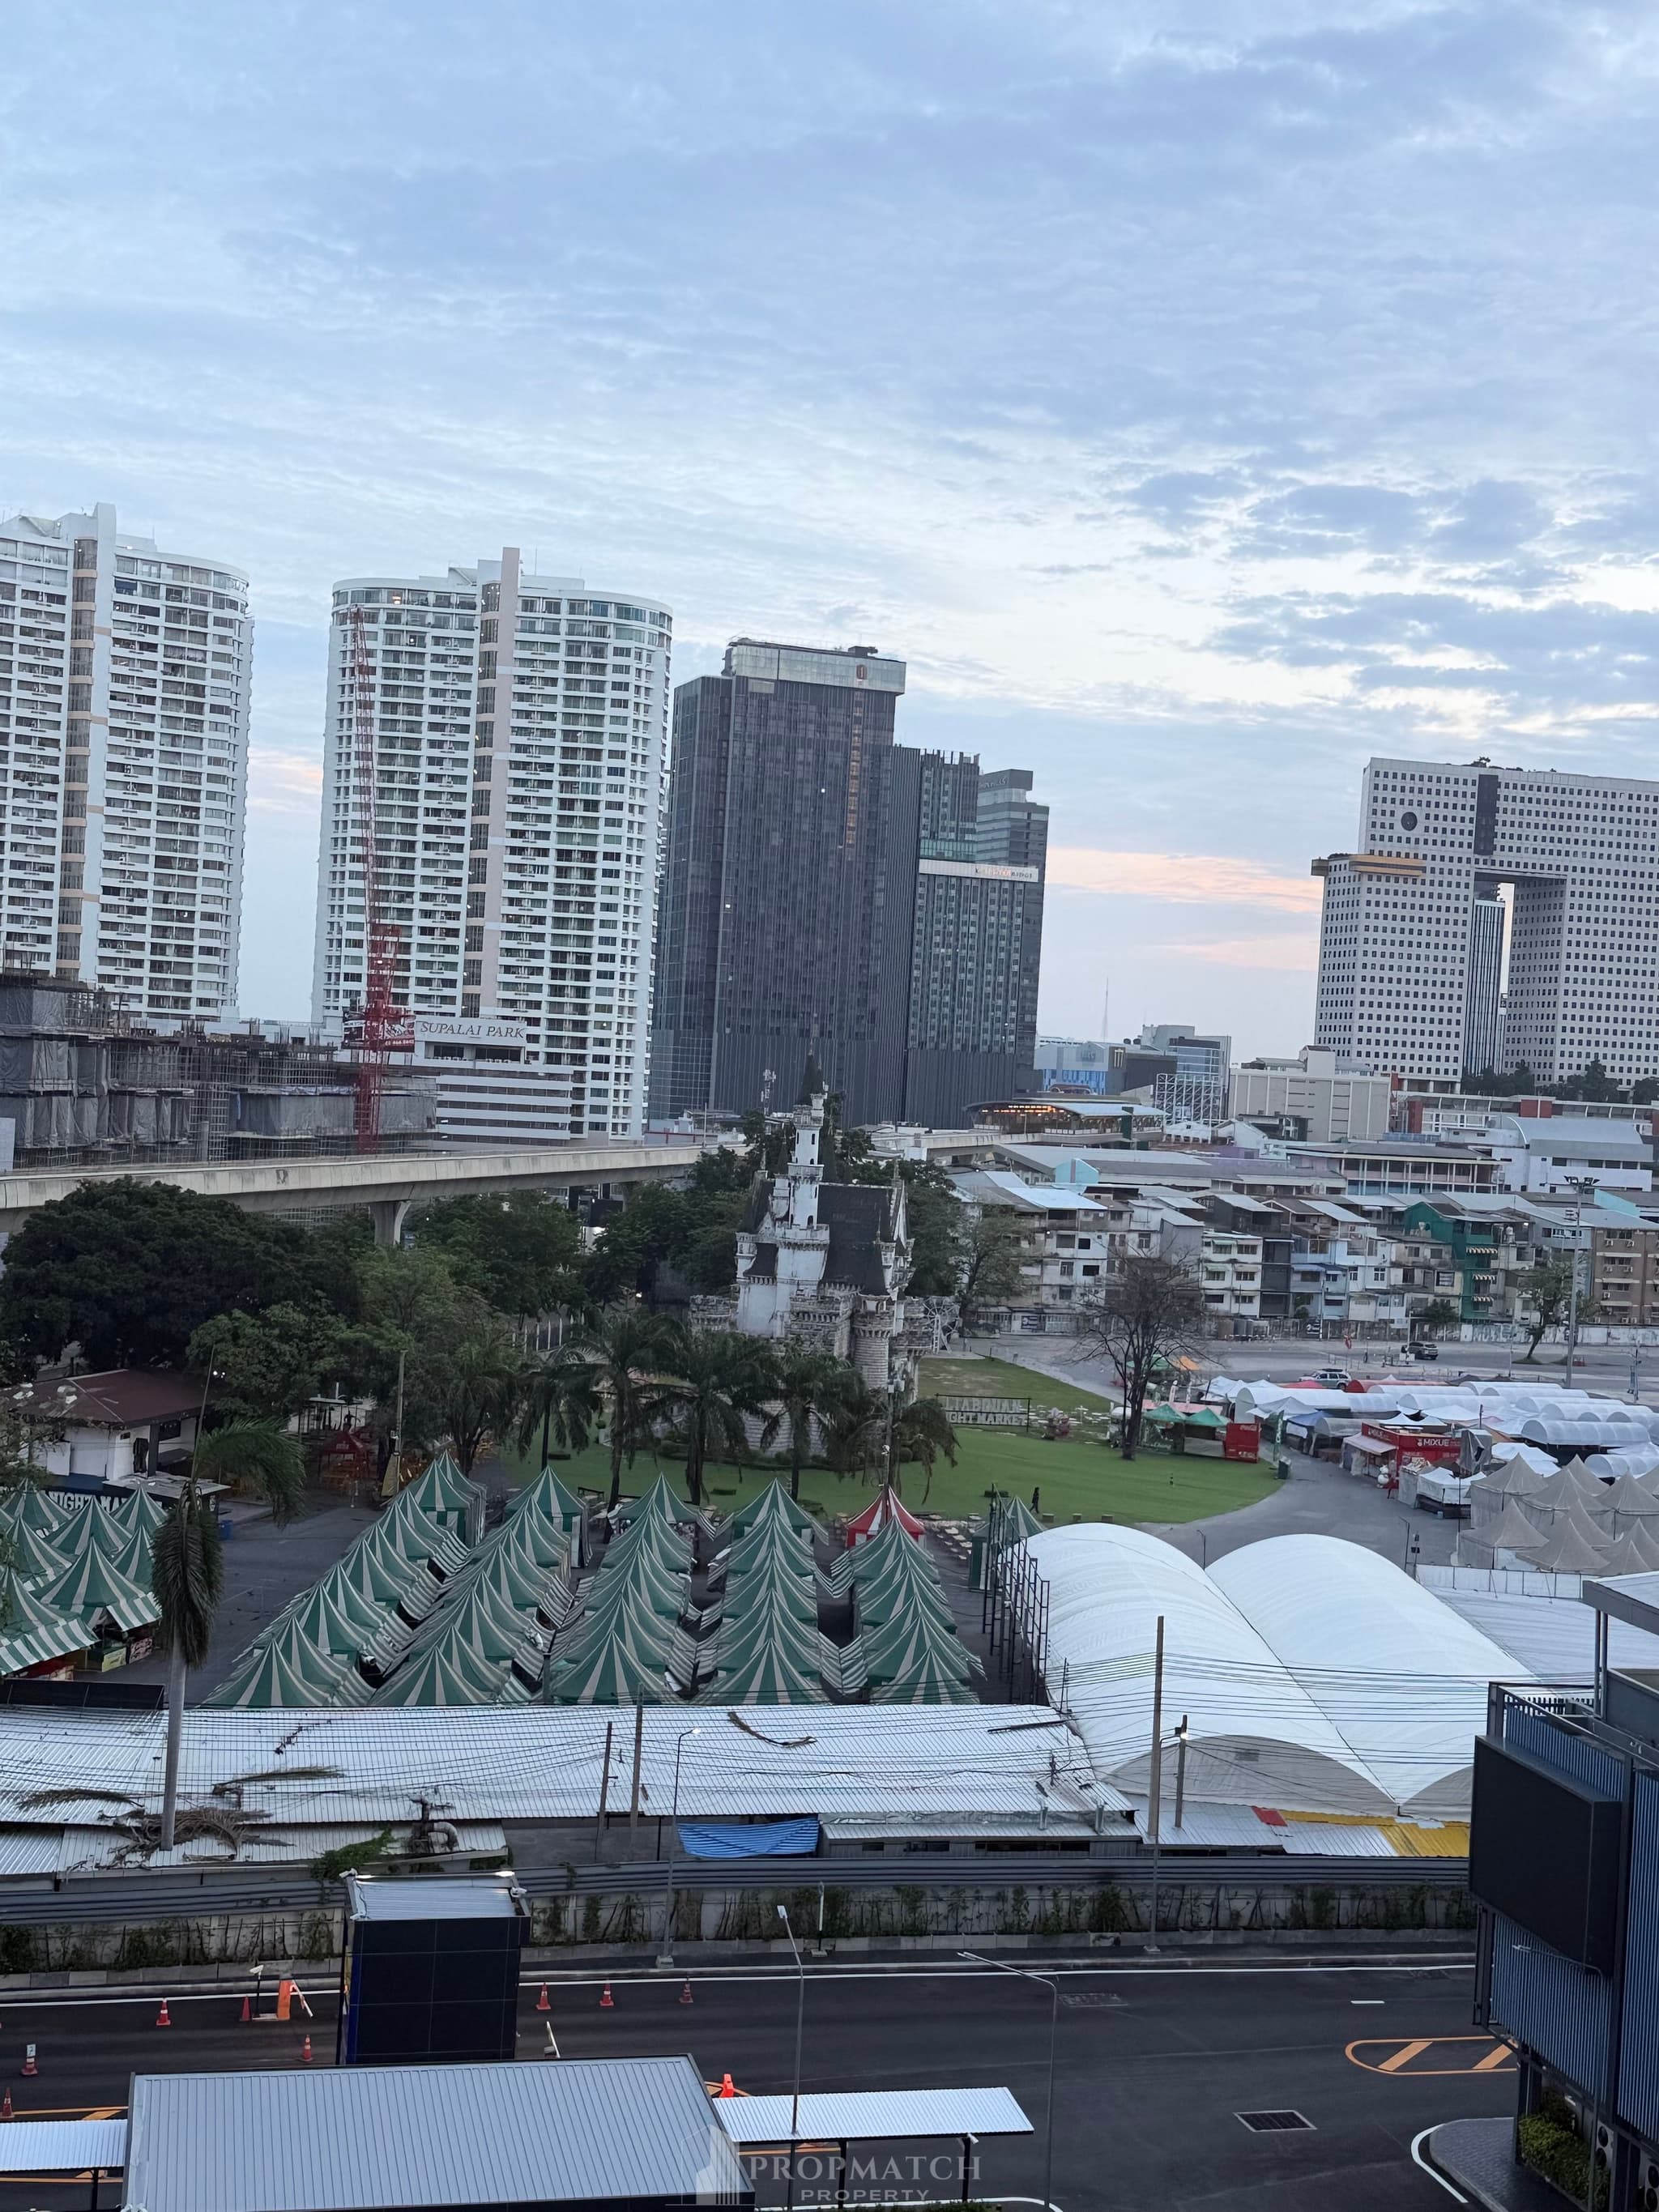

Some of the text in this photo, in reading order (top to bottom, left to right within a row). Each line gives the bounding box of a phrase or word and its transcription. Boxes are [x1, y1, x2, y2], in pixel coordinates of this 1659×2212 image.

[420, 1021, 526, 1039] SUPALAI PARK
[945, 1411, 975, 1423] IGHT
[1423, 1438, 1449, 1447] MIXUE
